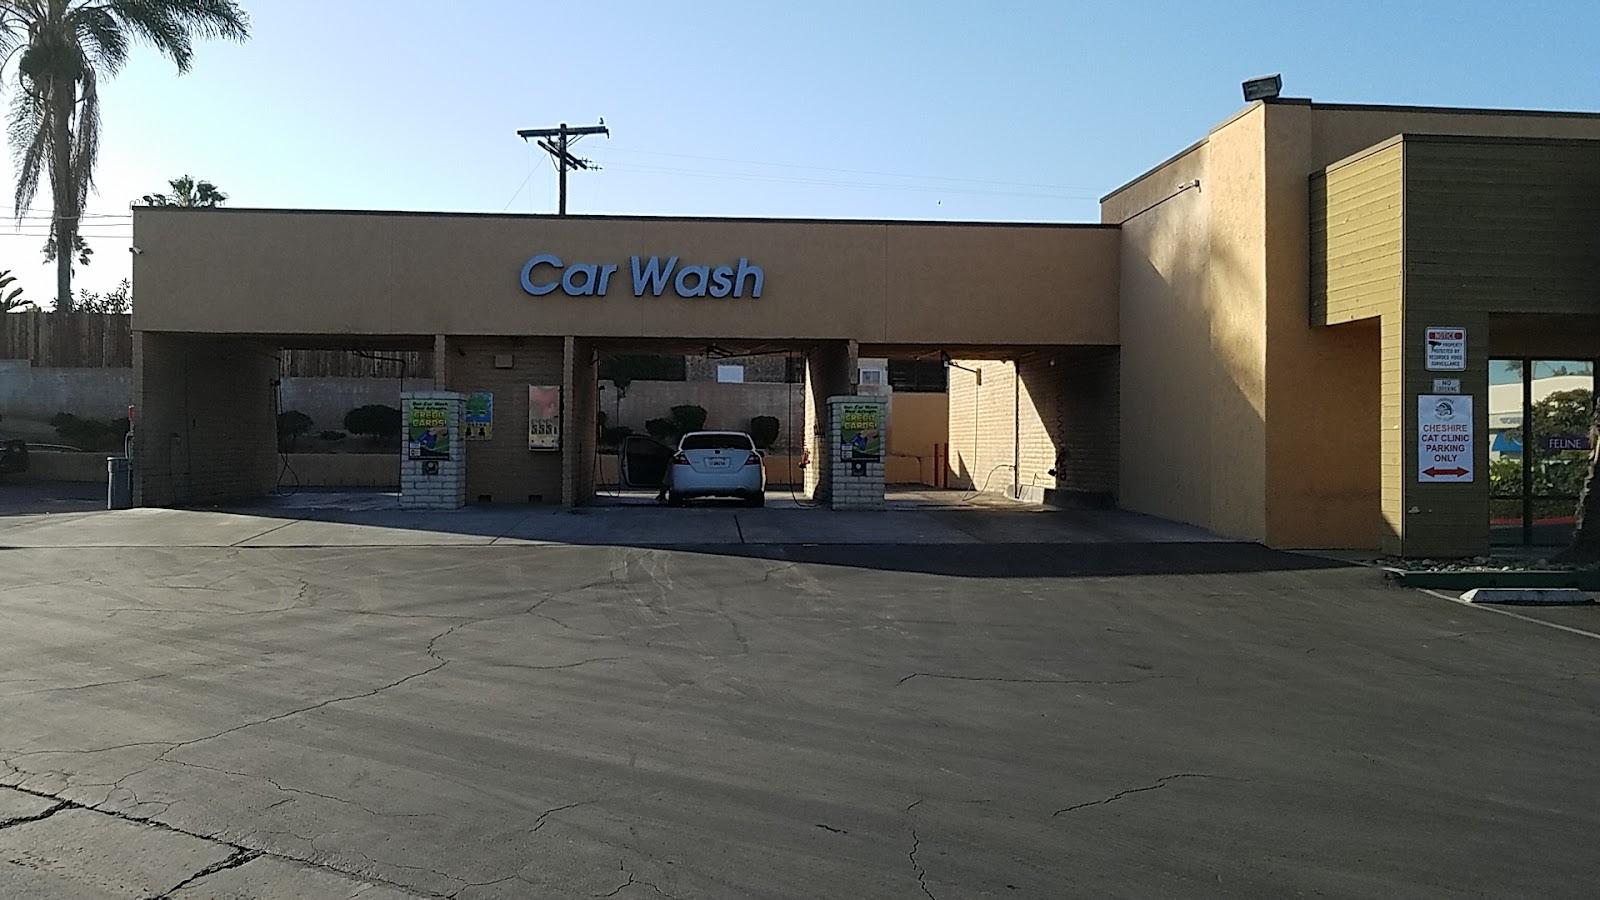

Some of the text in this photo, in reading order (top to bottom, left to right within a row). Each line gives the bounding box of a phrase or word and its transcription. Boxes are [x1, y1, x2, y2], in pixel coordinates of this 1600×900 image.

[520, 253, 765, 299] Car Wash
[1434, 332, 1455, 340] NOTICE
[413, 411, 445, 419] CREDIT
[412, 419, 447, 427] CARDS!
[844, 421, 877, 429] CARDS!
[1423, 424, 1468, 432] CHESHIRE
[1421, 434, 1470, 442] CAT CLINIC
[1549, 438, 1581, 448] FELINE
[1426, 444, 1465, 452] PARKING
[1434, 454, 1458, 462] ONLY
